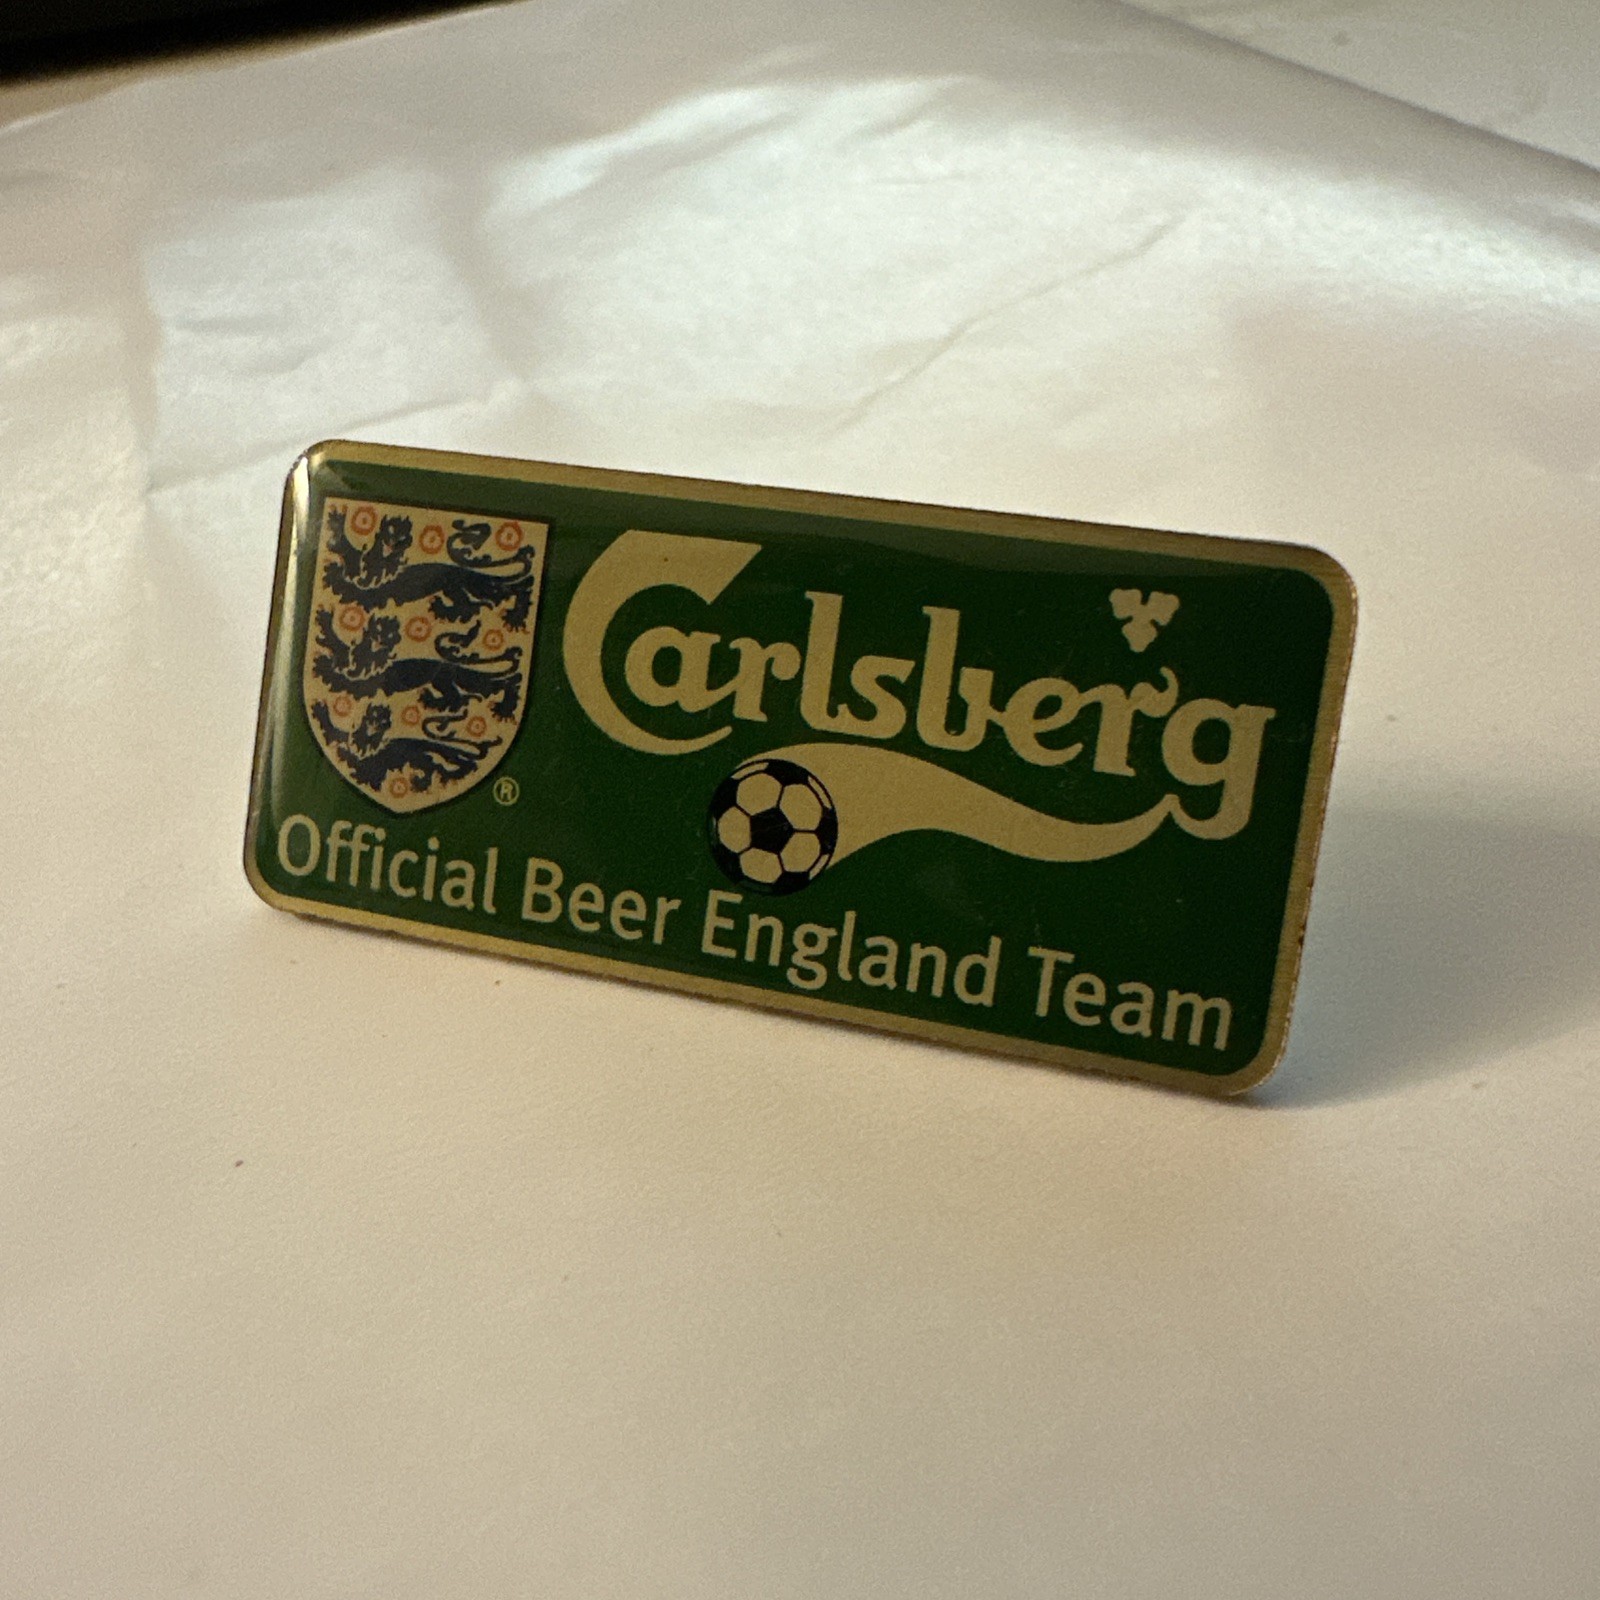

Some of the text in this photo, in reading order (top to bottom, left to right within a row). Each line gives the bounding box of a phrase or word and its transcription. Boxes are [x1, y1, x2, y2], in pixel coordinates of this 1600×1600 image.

[563, 529, 1276, 840] Carlsberg
[277, 814, 1233, 1050] Official Beer England Team
